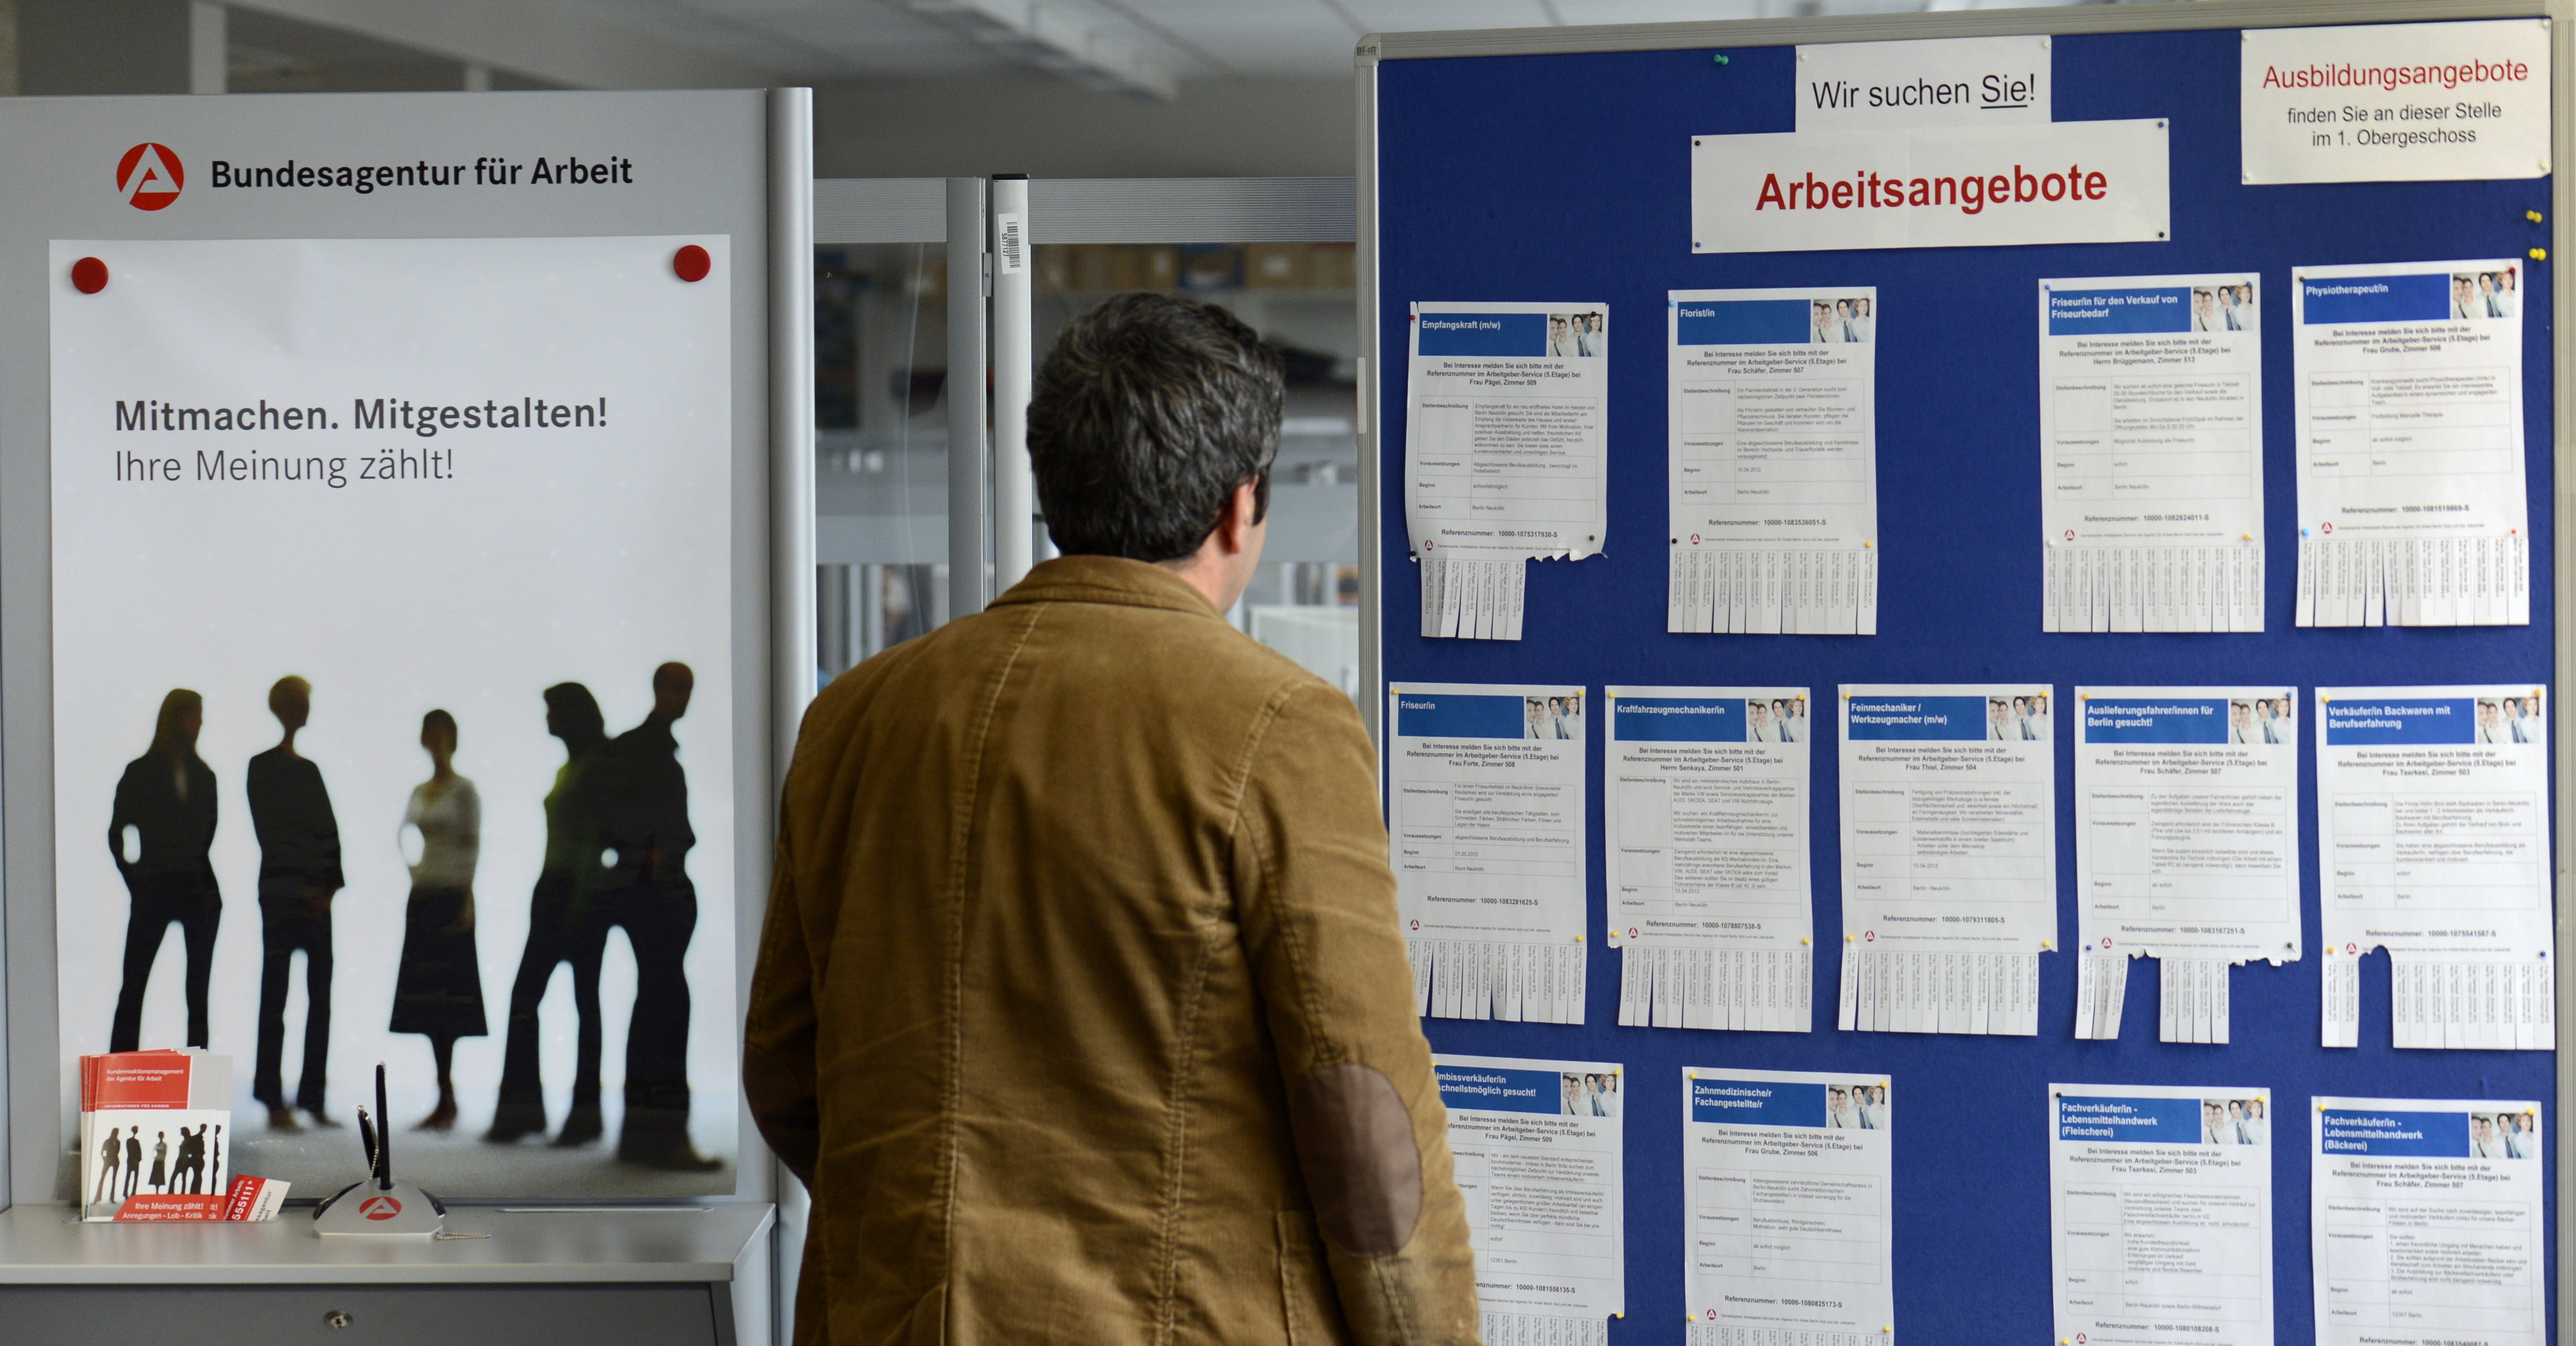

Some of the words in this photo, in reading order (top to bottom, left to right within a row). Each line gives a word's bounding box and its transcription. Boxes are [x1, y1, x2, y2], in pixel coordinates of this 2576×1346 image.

[2263, 58, 2527, 91] Ausbildungsangebote
[1812, 81, 1859, 108] Wir
[1869, 78, 1969, 107] suchen
[1980, 73, 2034, 109] Sie!
[2287, 107, 2336, 123] finden
[2342, 105, 2368, 122] Sie
[2374, 109, 2393, 121] an
[2399, 104, 2450, 120] dieser
[2455, 102, 2501, 118] Stelle
[2312, 131, 2330, 146] im
[2338, 130, 2350, 145] 1.
[2357, 127, 2476, 148] Obergeschoss
[212, 159, 466, 194] Bundesagentur
[474, 157, 522, 184] für
[530, 156, 632, 184] Arbeit
[1755, 163, 2107, 215] Arbeitsangebote
[2306, 283, 2388, 297] Physiotherapeut/in
[2052, 297, 2091, 306] Friseur/in
[2094, 296, 2106, 305] für
[2108, 296, 2124, 305] den
[2126, 295, 2159, 305] Verkauf
[1680, 308, 1715, 317] Florist/in
[2052, 308, 2109, 318] Friseurbedarf
[1422, 320, 1477, 330] Empfangskraft
[1479, 320, 1500, 330] (m/w)
[116, 399, 338, 431] Mitmachen.
[355, 397, 606, 437] Mitgestalten!
[117, 450, 180, 481] Ihre
[197, 449, 346, 487] Meinung
[360, 448, 452, 479] zählt!
[1400, 701, 1435, 709] Friseur/in
[1617, 705, 1725, 716] Kraftfahrzeugmechaniker/in
[1851, 703, 1916, 712] Feinmechaniker
[2088, 705, 2198, 716] Auslieferungsfahrer/innen
[2201, 706, 2213, 714] für
[2328, 706, 2382, 716] Verkäufer/in
[2384, 706, 2434, 715] Backwaren
[2435, 705, 2450, 714] mit
[1851, 714, 1922, 725] Werkzeugmacher
[1924, 715, 1947, 725] (m/w)
[2088, 717, 2113, 726] Berlin
[2115, 717, 2152, 728] gesucht!
[2329, 718, 2401, 729] Berufserfahrung
[1464, 752, 1521, 760] Arbeitgeber-Service
[1481, 897, 1538, 906] 10000-1083281625-S
[1435, 1072, 1506, 1083] Imbissverkäufer/in
[1502, 1088, 1535, 1097] gesucht!
[1695, 1085, 1772, 1097] Zahnmedizinische/r
[1695, 1097, 1763, 1109] Fachangestellte/r
[2061, 1103, 2132, 1113] Fachverkäufer/in
[2062, 1114, 2157, 1125] Lebensmittelhandwerk
[2324, 1116, 2395, 1127] Fachverkäufer/in
[1500, 1133, 1517, 1141] Pägel,
[2062, 1126, 2113, 1137] (Fleischerei)
[2324, 1128, 2423, 1139] Lebensmittelhandwerk
[2324, 1140, 2367, 1152] (Bäckerei)
[151, 1202, 182, 1211] Meinung
[122, 1212, 162, 1220] Anregungen
[1516, 1284, 1575, 1293] 10000-1081556135-S
[1725, 1295, 1777, 1304] Referenznummer:
[1781, 1299, 1842, 1308] 10000-1080825173-S
[2095, 1321, 2149, 1330] Referenznummer:
[2154, 1324, 2219, 1332] 10000-1080108208-S
